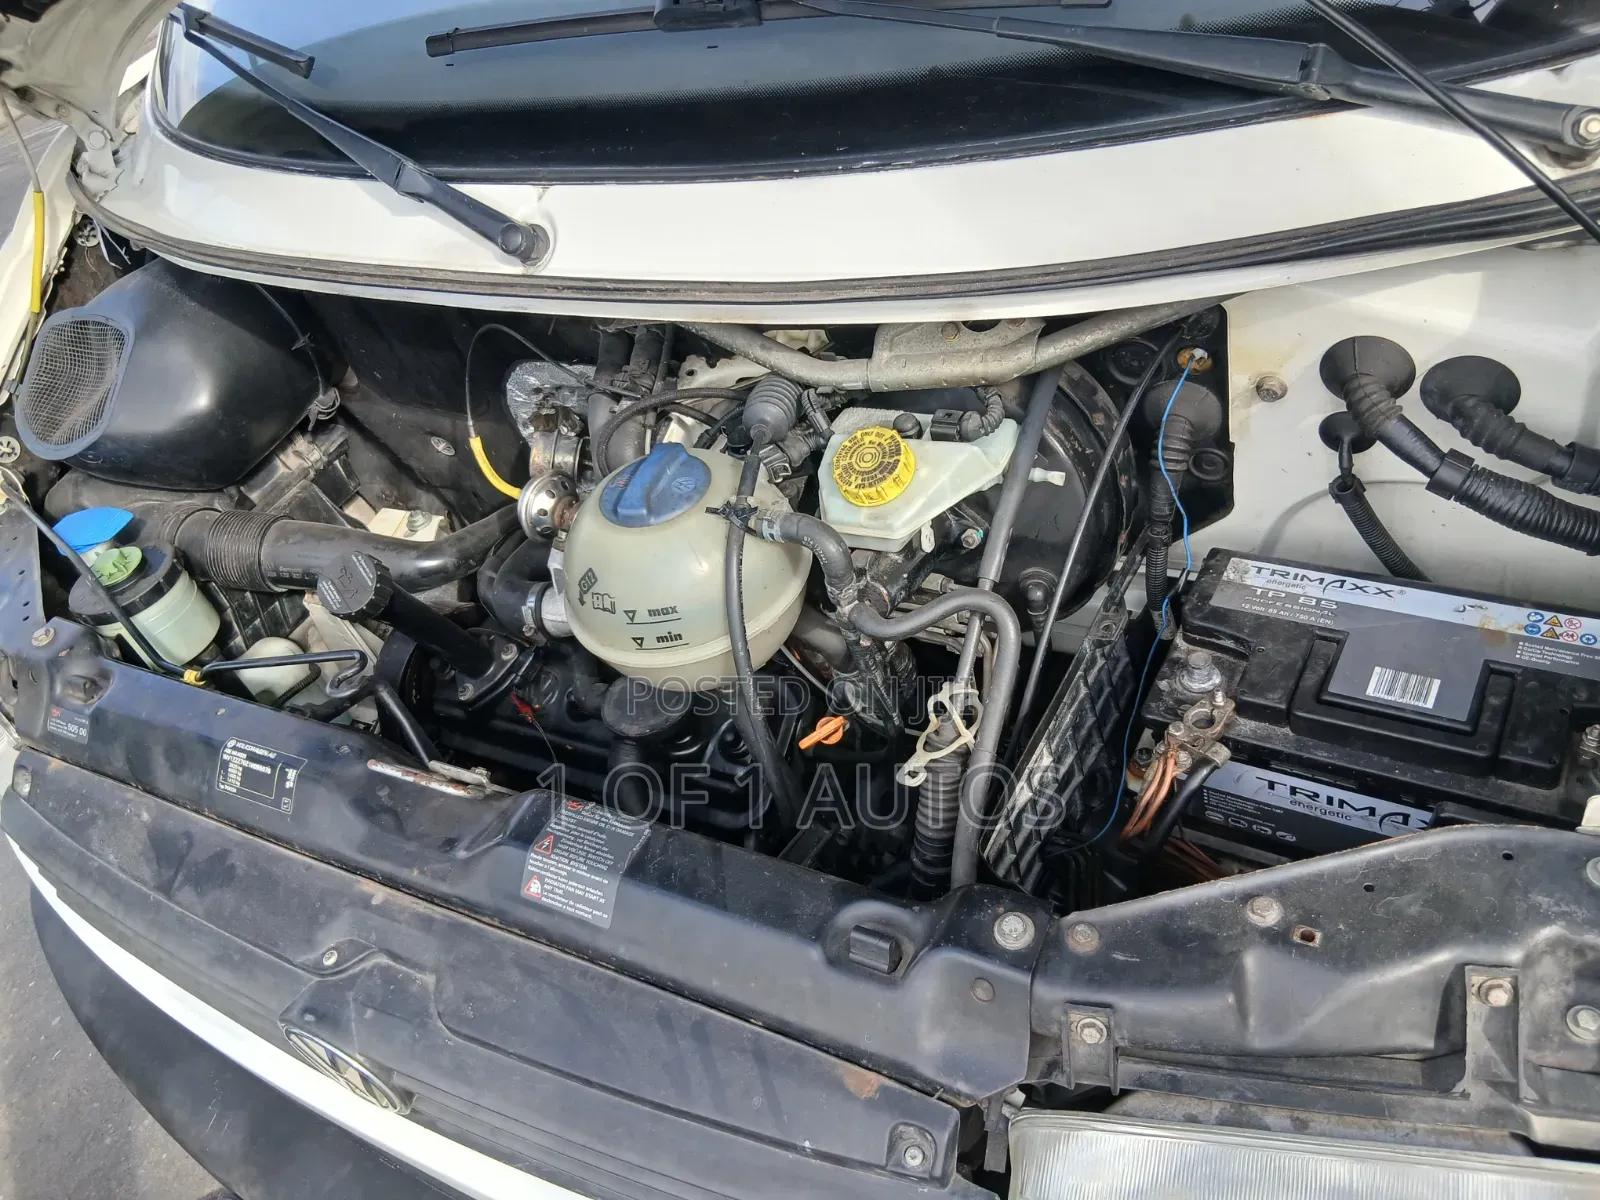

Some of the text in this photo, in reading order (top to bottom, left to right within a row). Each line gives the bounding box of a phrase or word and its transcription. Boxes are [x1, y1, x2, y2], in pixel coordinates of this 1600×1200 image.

[580, 570, 596, 592] G12
[1266, 578, 1307, 590] energetic
[1251, 587, 1338, 609] TP 85
[648, 606, 678, 617] max
[656, 631, 682, 643] min
[1289, 799, 1352, 821] energetic
